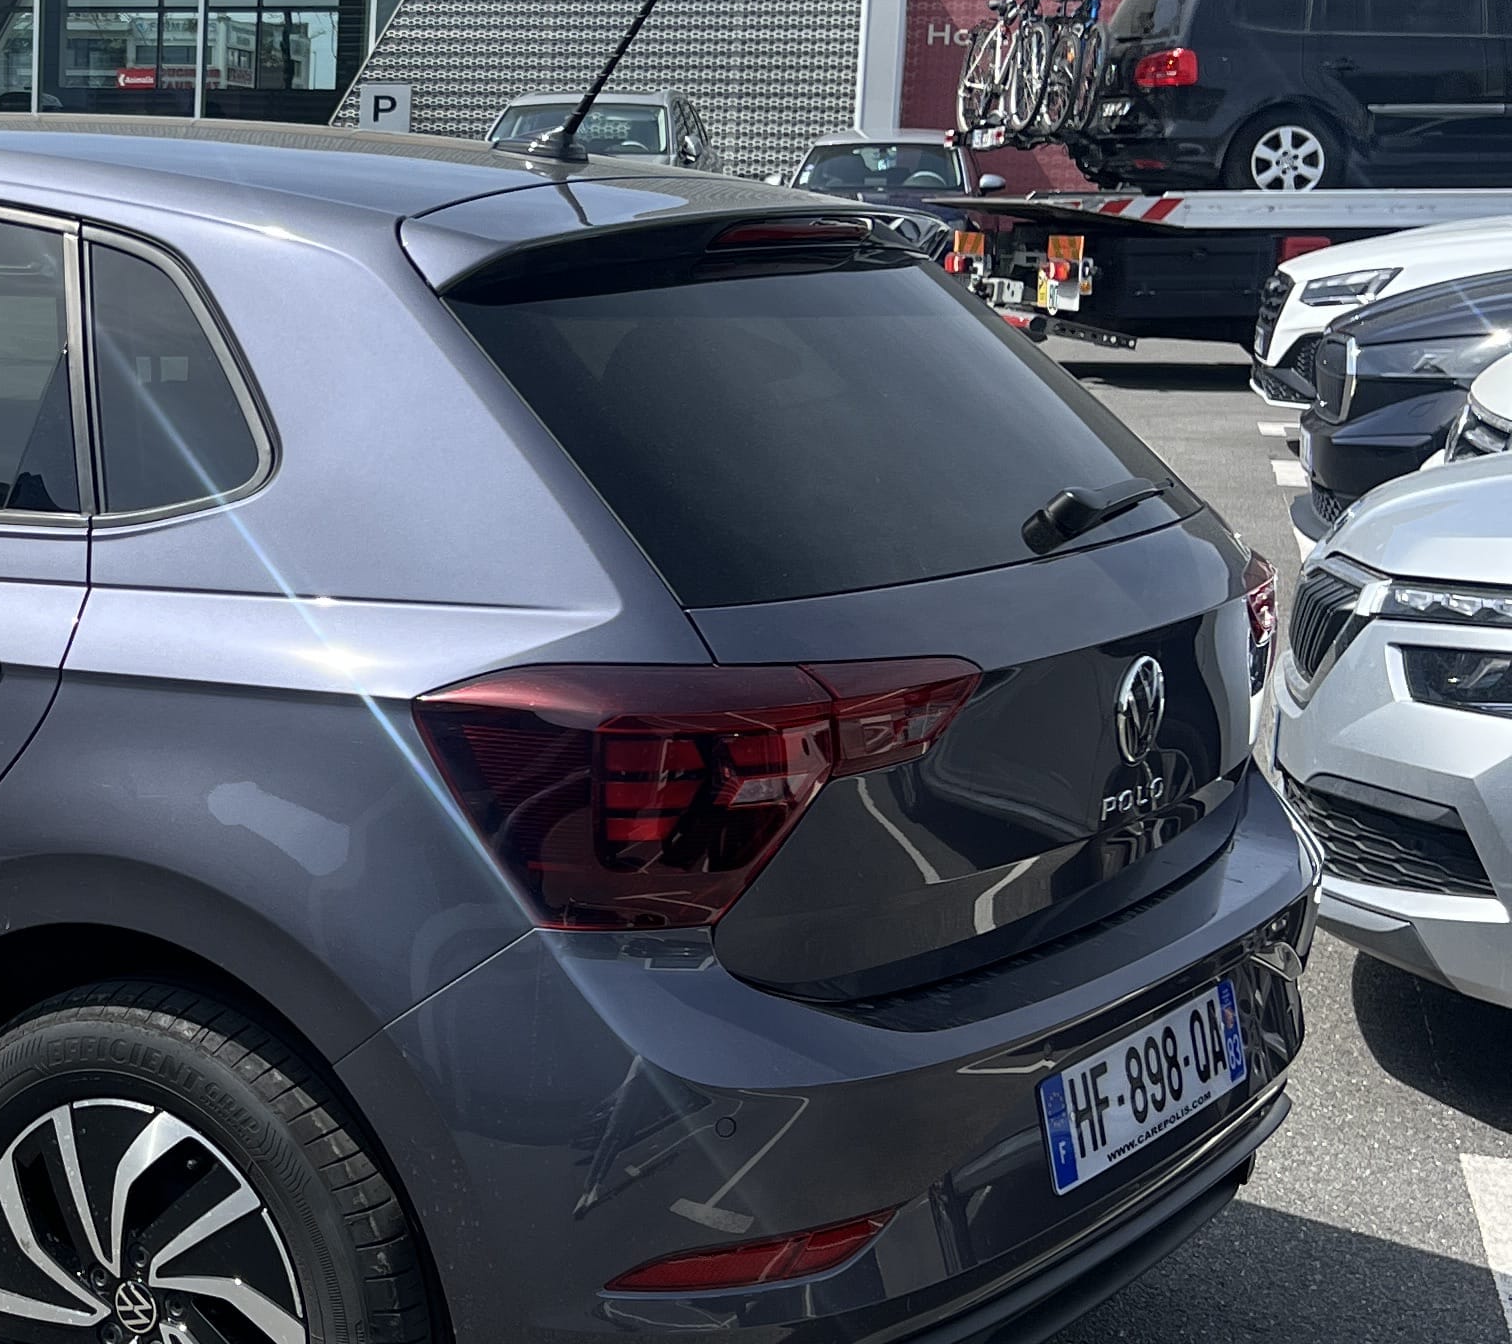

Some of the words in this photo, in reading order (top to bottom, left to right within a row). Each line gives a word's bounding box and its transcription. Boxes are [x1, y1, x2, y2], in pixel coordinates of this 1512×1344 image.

[373, 95, 397, 123] P
[1101, 777, 1164, 821] POLO
[1226, 1033, 1242, 1070] 83
[1106, 1090, 1212, 1163] WWW.CAREPOLIS.COM
